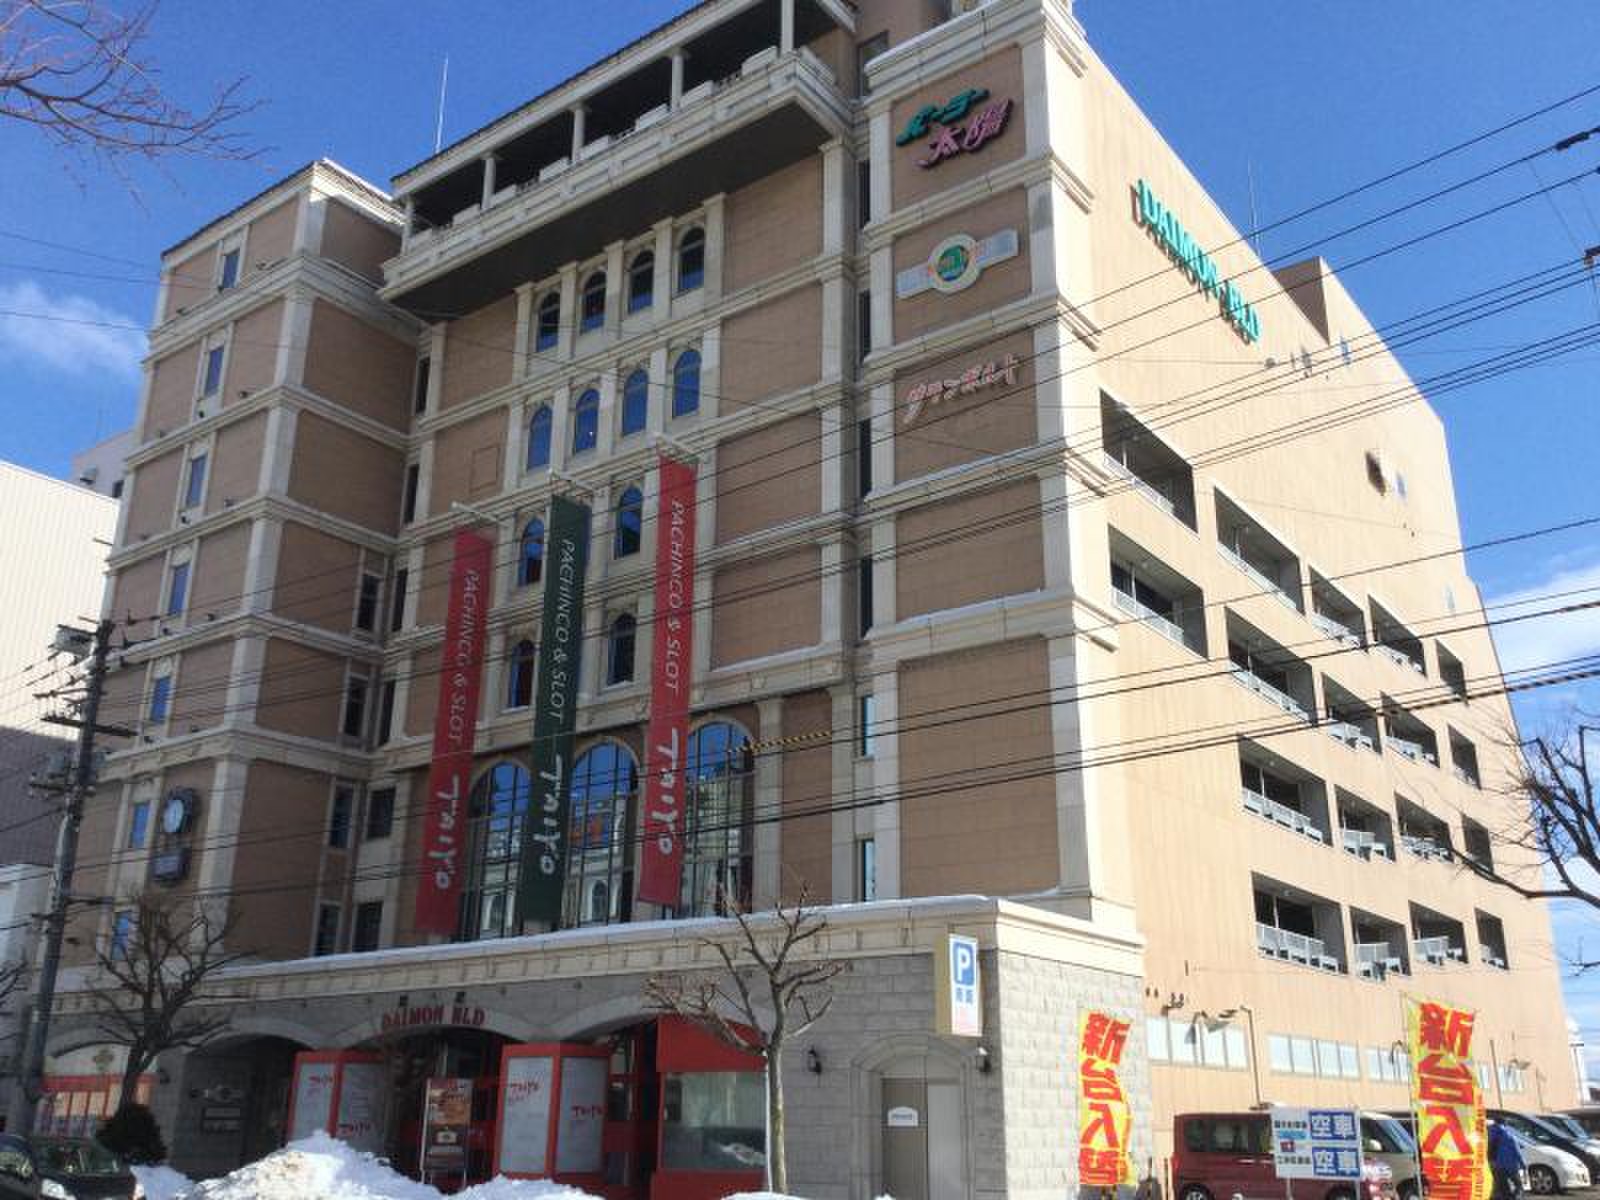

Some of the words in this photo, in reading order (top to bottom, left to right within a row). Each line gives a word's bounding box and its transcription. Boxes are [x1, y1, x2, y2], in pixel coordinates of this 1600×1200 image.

[668, 499, 686, 611] PACHINCO
[556, 538, 576, 643] PACHINCO
[666, 617, 682, 632] &
[553, 648, 567, 662] &
[665, 639, 681, 693] SLOT
[448, 696, 466, 746] SLOT
[549, 669, 567, 724] SLOT
[1310, 1114, 1355, 1137] 空車
[1314, 1150, 1359, 1174] 空車
